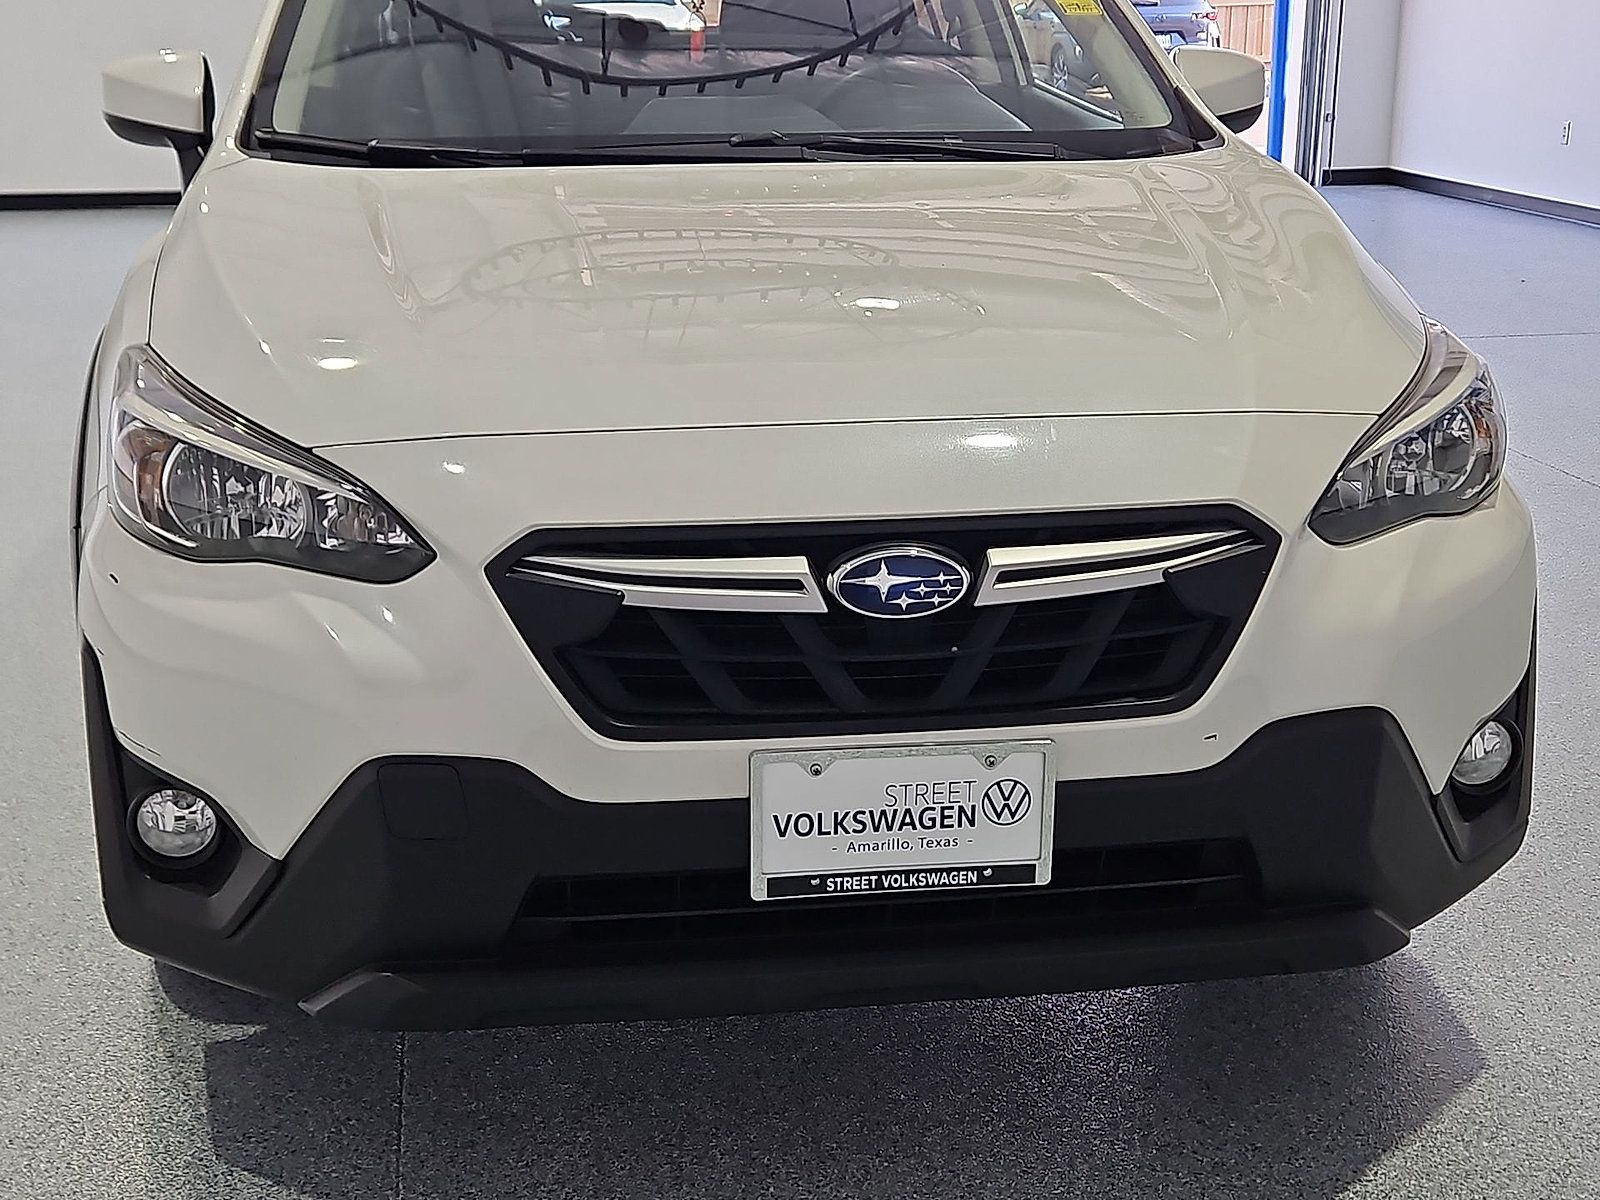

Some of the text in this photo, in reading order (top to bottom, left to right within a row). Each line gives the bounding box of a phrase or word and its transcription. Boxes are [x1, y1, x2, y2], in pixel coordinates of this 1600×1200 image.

[884, 780, 978, 808] STREET
[772, 804, 977, 839] VOLKSWAGEN
[846, 836, 959, 853] Amarillo, Texas
[826, 870, 978, 892] STREET VOLKSWAGEN
